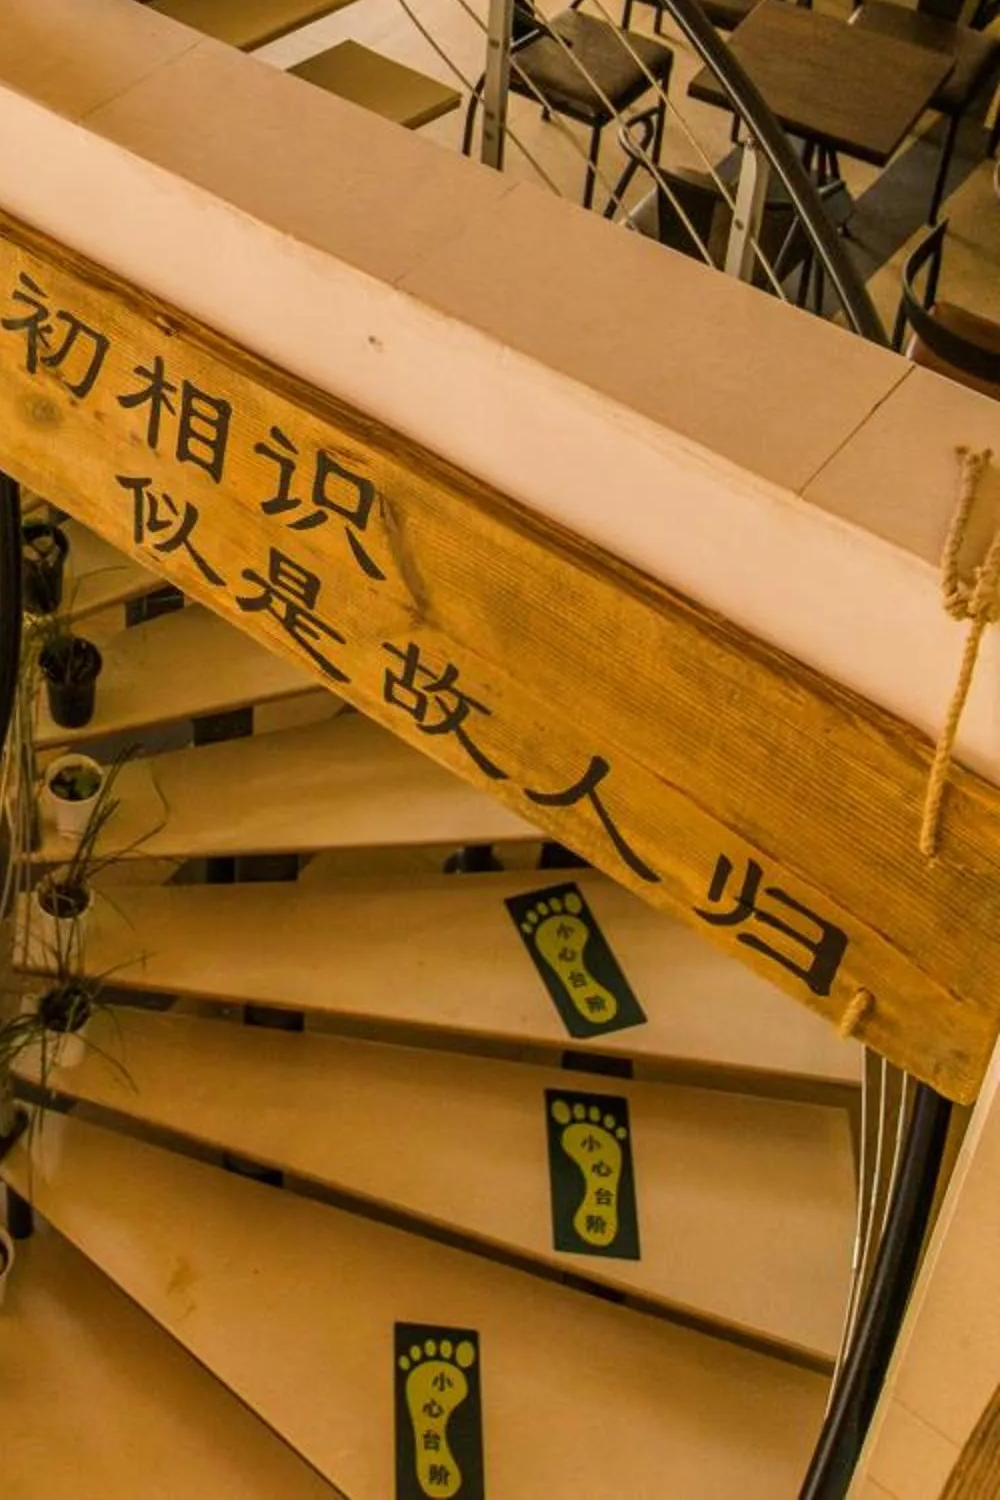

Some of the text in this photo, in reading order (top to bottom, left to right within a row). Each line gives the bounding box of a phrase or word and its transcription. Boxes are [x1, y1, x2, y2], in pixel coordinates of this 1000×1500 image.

[116, 474, 852, 1000] 似是故人归
[556, 923, 608, 1014] 小心台阶
[580, 1132, 614, 1235] 小心台阶
[422, 1371, 454, 1486] 小心台阶
